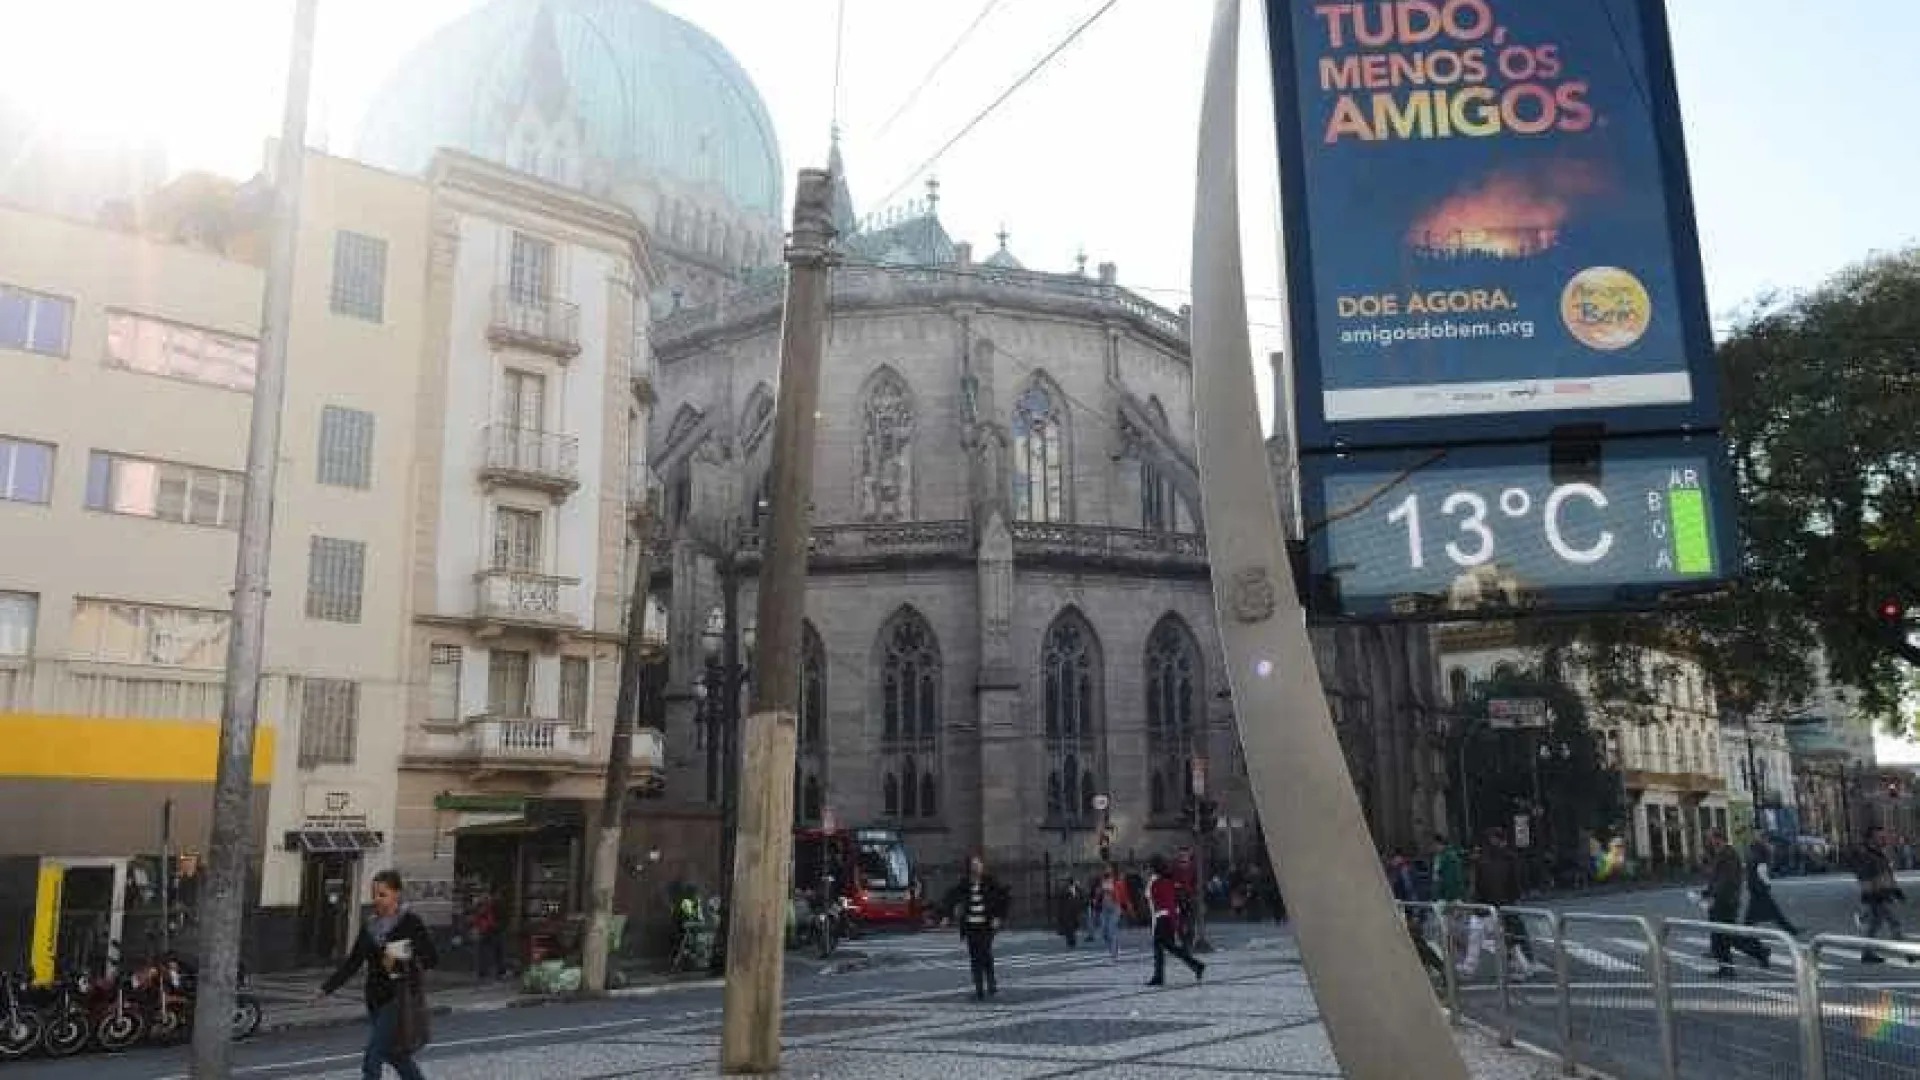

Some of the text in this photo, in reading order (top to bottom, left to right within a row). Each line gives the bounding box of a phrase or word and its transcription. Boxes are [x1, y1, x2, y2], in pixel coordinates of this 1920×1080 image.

[1315, 0, 1507, 47] TUDO,
[1319, 45, 1561, 90] MENOS OS
[1337, 288, 1519, 317] DOE AGORA.
[1341, 319, 1535, 347] amigosdobem.org
[1667, 468, 1699, 489] AR
[1387, 482, 1614, 569] 13°C
